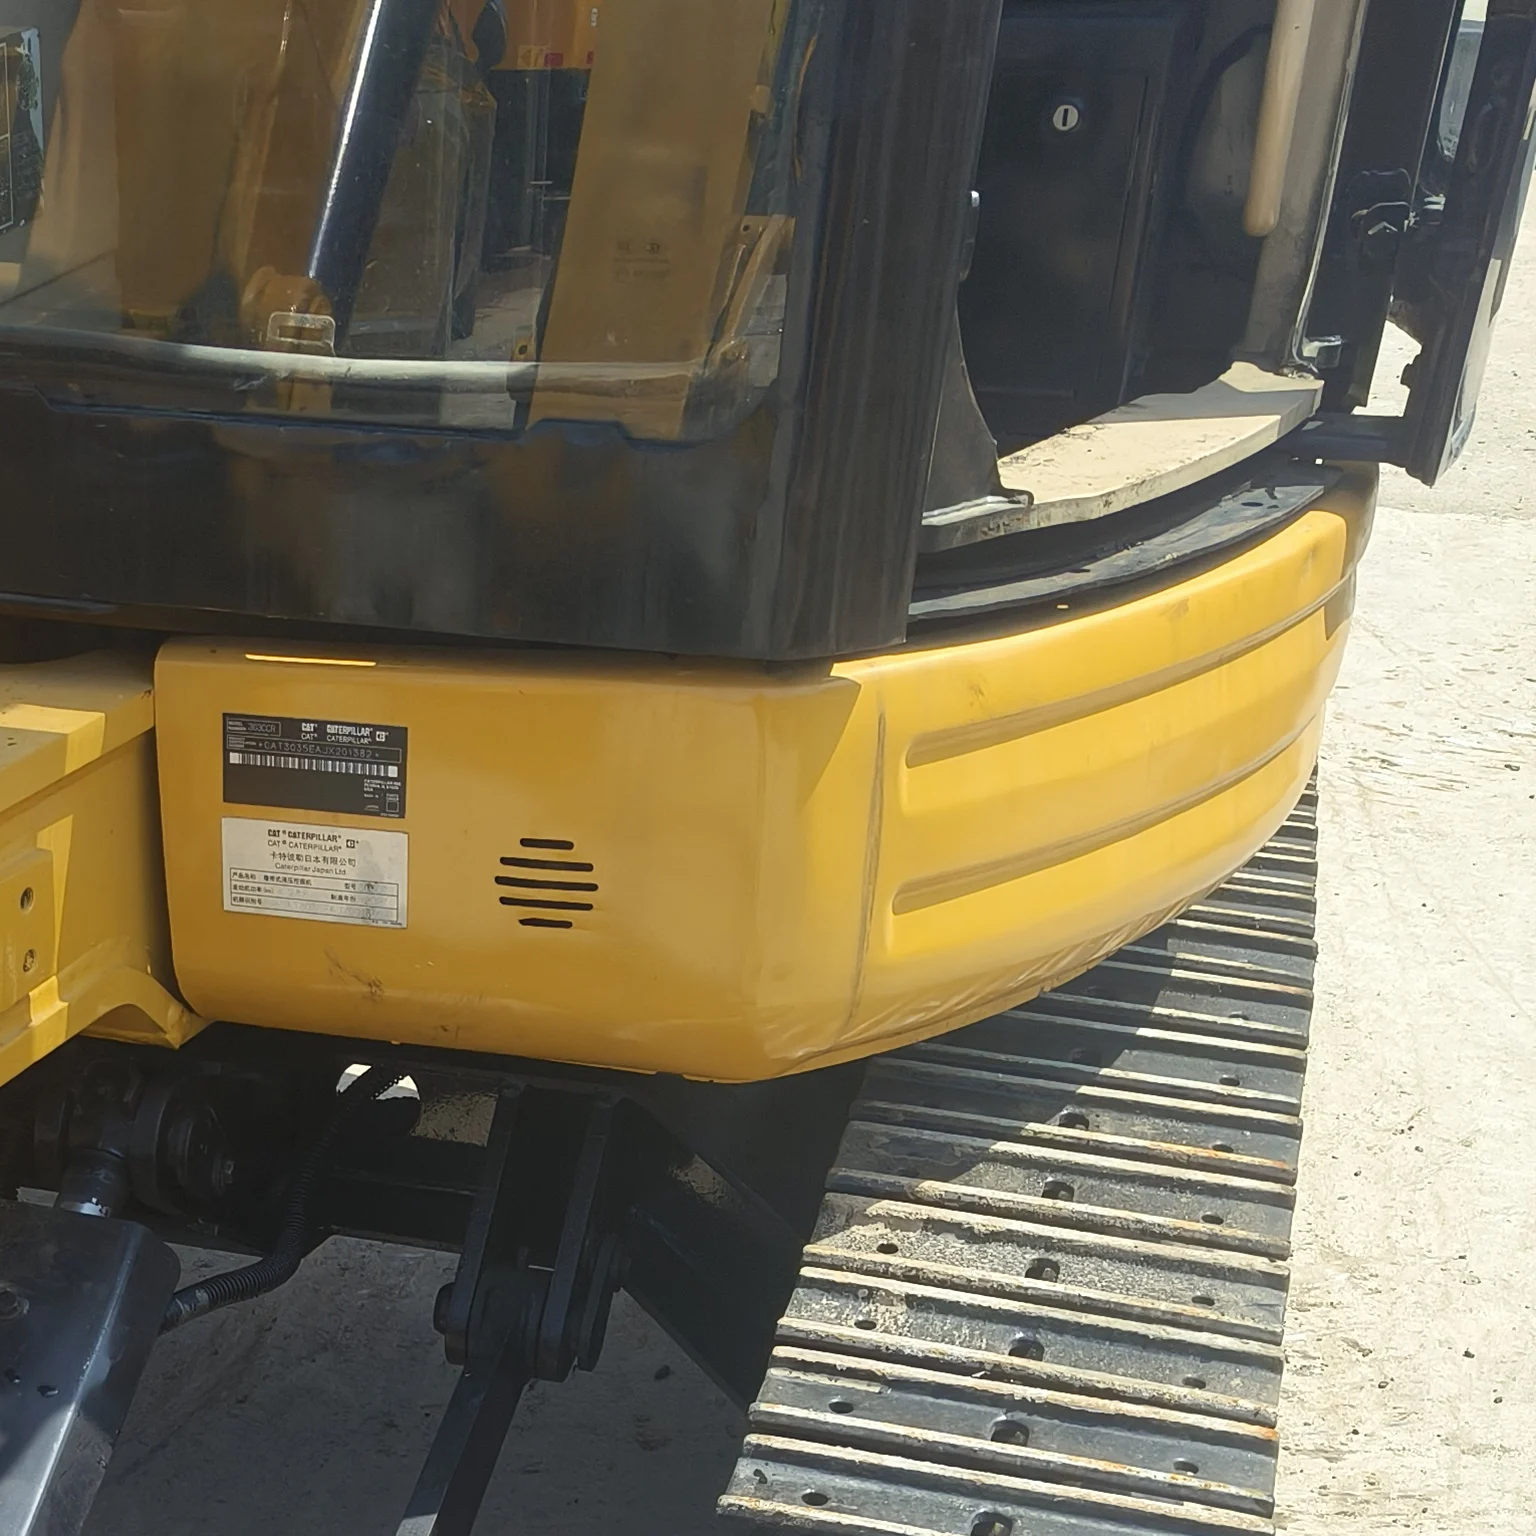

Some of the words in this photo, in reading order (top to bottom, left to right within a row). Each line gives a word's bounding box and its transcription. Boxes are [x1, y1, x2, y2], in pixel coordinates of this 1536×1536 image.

[301, 722, 314, 732] CAT
[326, 724, 371, 737] CATERPILLAR
[301, 733, 314, 741] CAT
[326, 734, 371, 745] CATERPILLAR
[267, 829, 280, 838] CAT
[288, 831, 338, 843] CATERPILLAR
[267, 839, 281, 848] CAT
[288, 841, 339, 852] CATERPILLAR
[275, 862, 311, 872] Caterpillar
[312, 865, 333, 874] Japan
